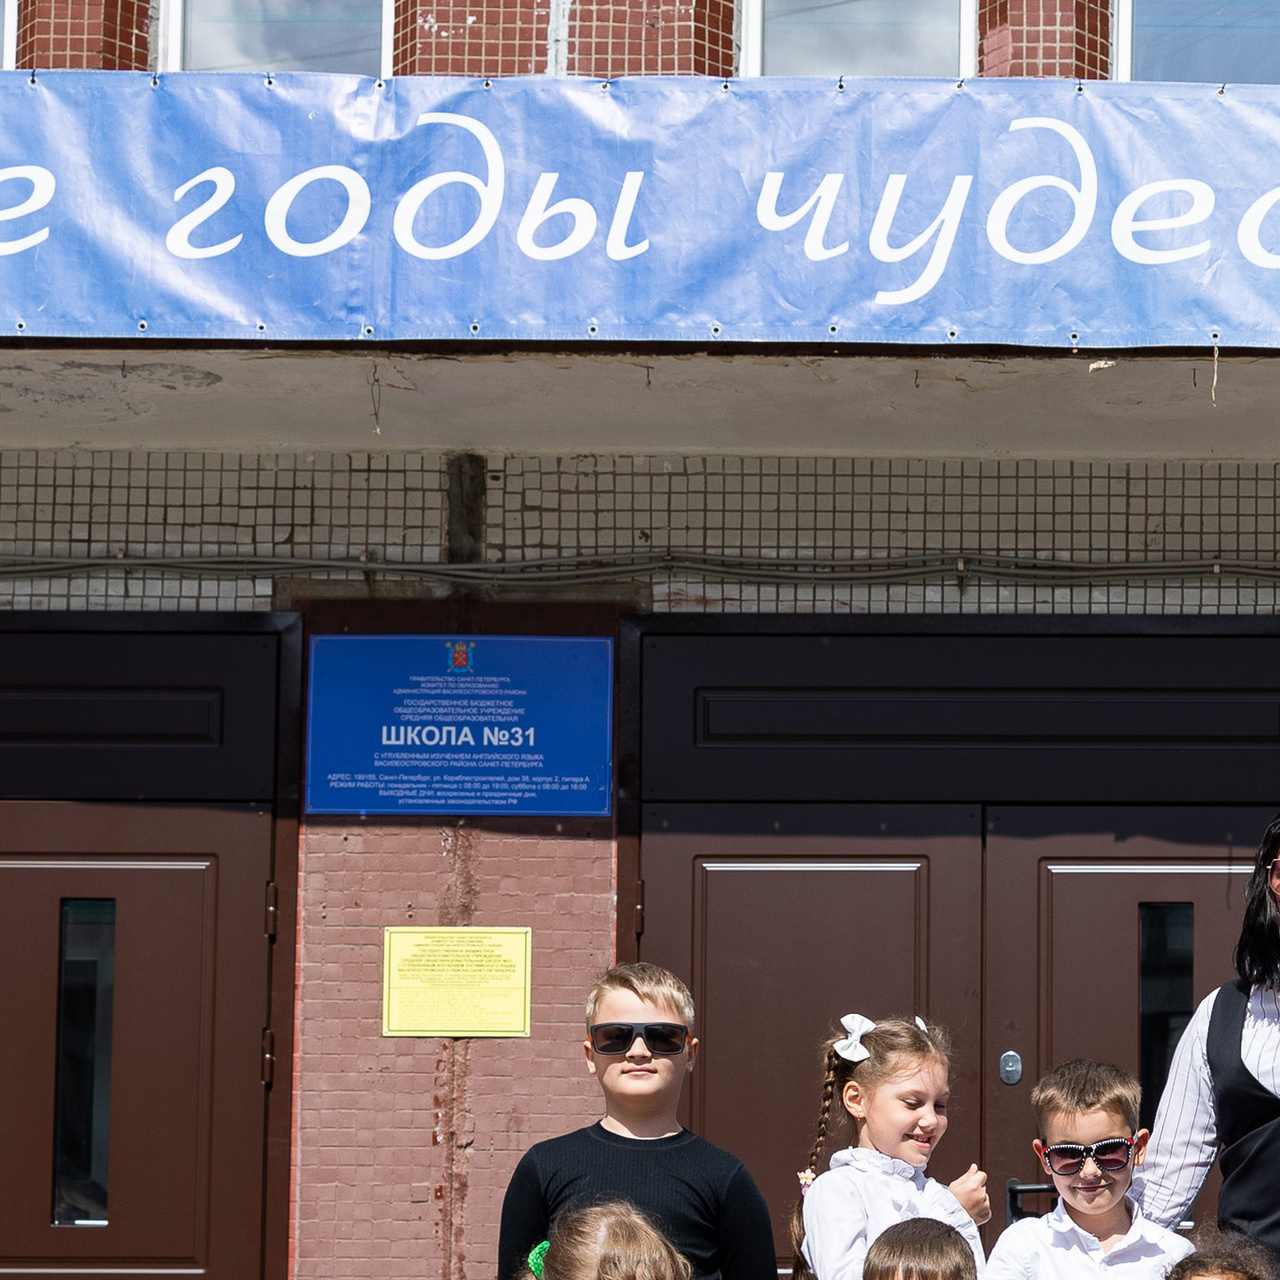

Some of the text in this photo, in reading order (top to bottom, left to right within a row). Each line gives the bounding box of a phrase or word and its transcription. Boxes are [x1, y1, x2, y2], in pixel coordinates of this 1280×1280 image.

[165, 111, 650, 262] годы
[403, 699, 469, 707] ГОСУДАРСТВЕННОЕ
[393, 707, 526, 715] ОБЩЕОБРАЗОВАТЕЛЬНОЕ УЧРЕЖДЕНИЕ
[433, 714, 519, 722] ОБЩЕОБРАЗОВАТЕЛЬНАЯ
[381, 725, 536, 747] ШКОЛА №31
